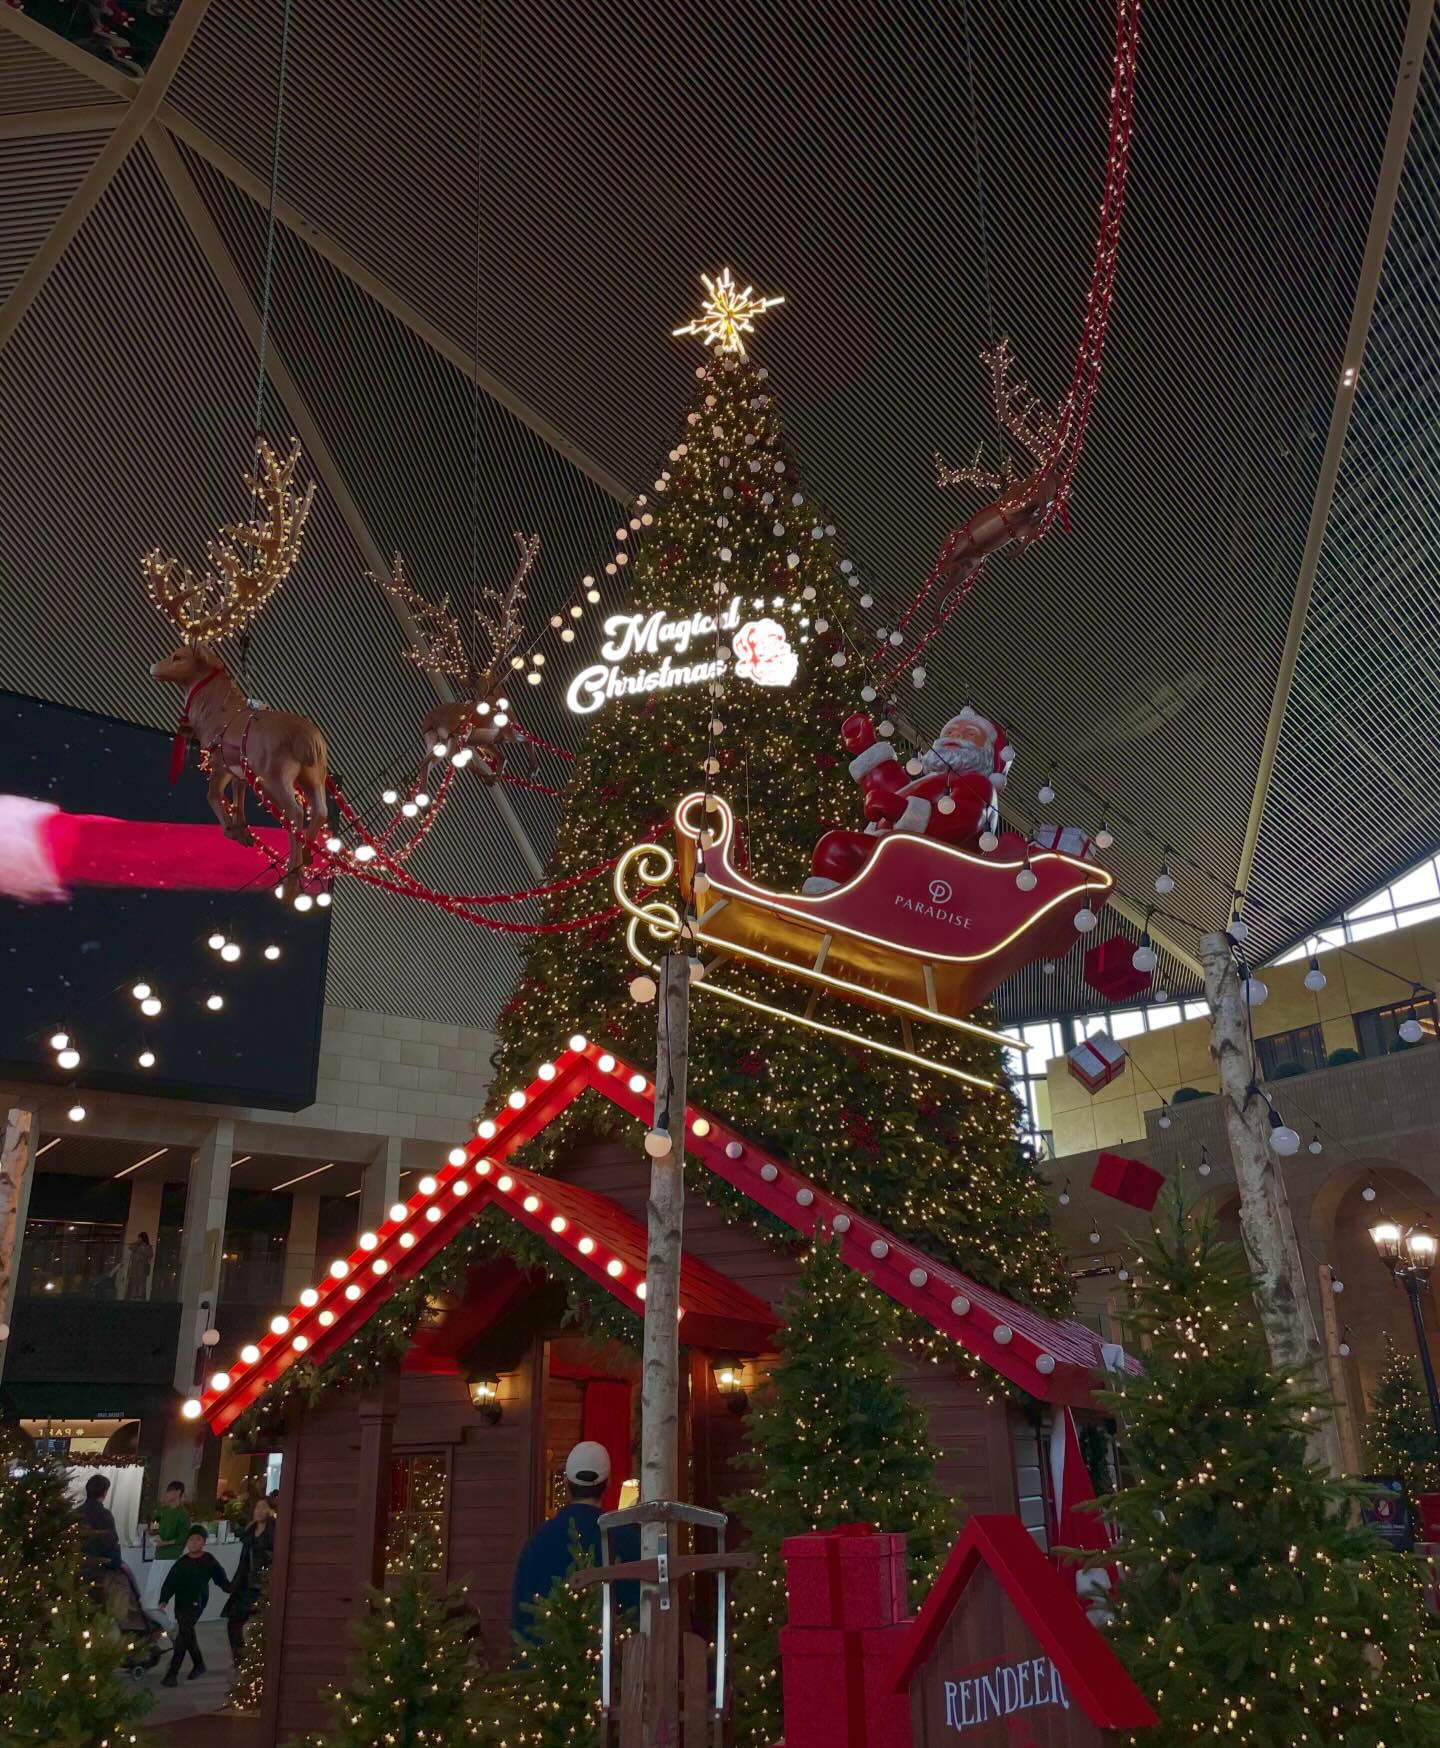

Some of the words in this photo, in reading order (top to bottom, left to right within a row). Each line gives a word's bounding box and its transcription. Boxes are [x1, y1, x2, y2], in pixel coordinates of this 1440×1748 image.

[602, 597, 742, 661] Magical
[567, 656, 727, 713] Christmas
[895, 895, 973, 929] PARADISE
